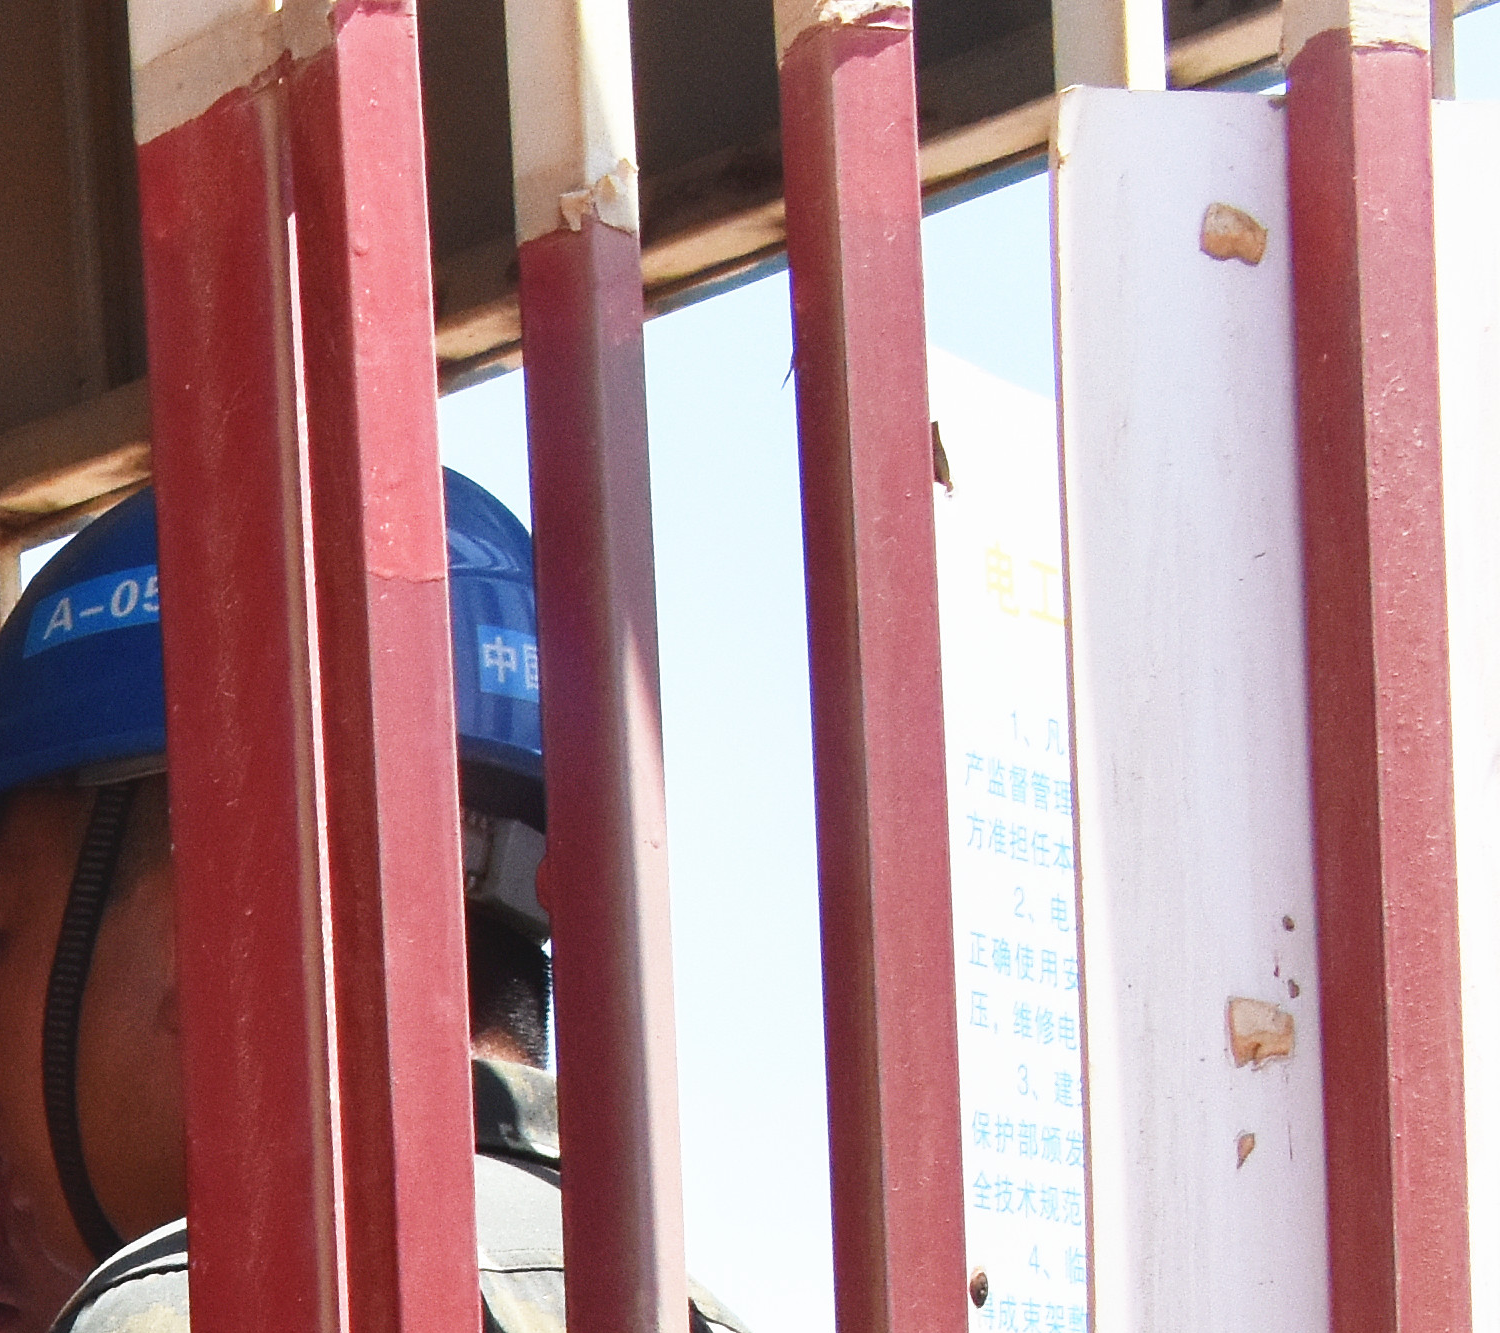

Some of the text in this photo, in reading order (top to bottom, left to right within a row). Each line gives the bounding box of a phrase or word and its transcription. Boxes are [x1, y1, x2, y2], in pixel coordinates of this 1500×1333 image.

[985, 540, 1065, 626] 电工
[964, 748, 1072, 816] 产监督管理
[966, 810, 1073, 874] 方准担任本
[969, 930, 1077, 990] 正确使用安
[1017, 1063, 1082, 1108] 3、建
[972, 1110, 1084, 1167] 保护部颁发
[972, 1169, 1083, 1227] 全技术规范
